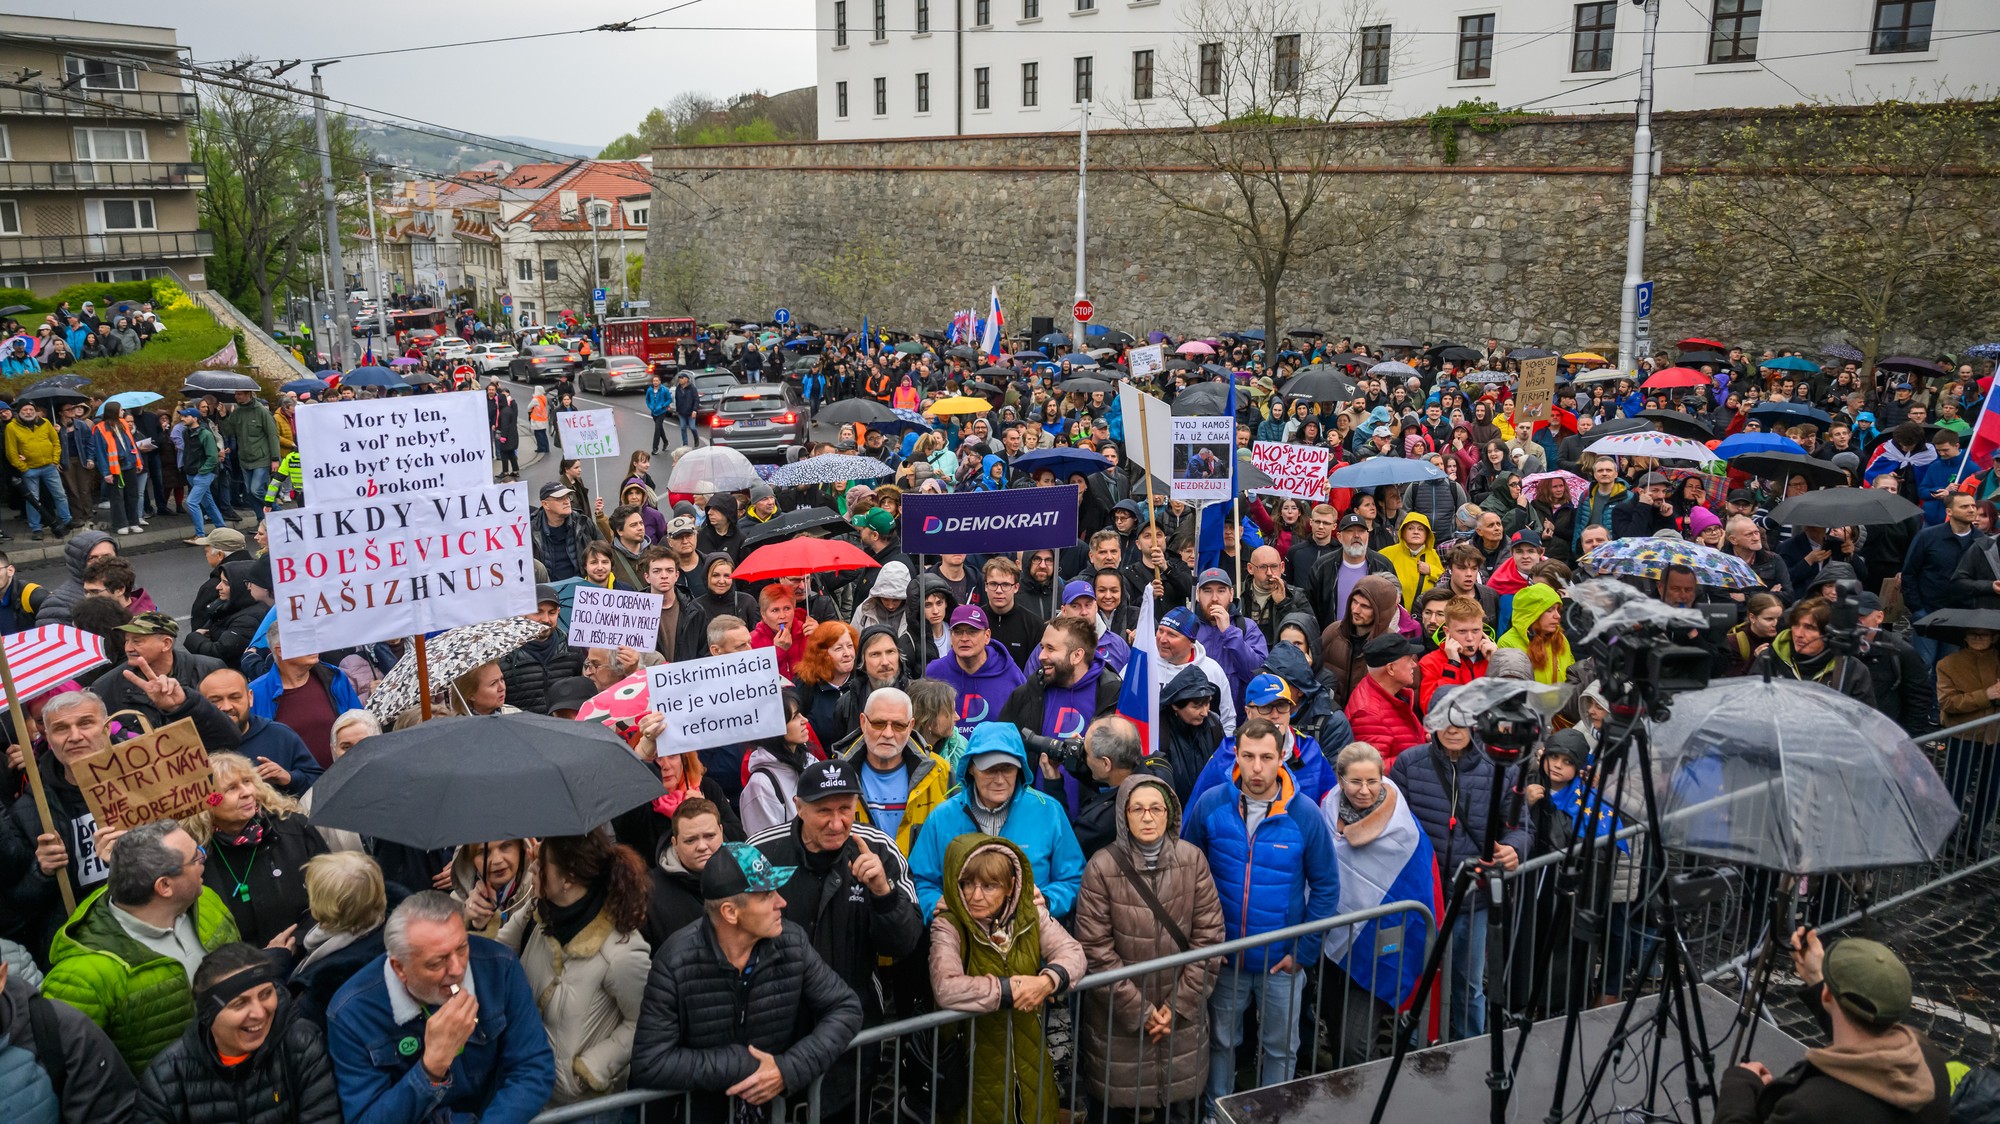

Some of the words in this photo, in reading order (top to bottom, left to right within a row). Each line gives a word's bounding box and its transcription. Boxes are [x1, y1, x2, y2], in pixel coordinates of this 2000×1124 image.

[1074, 306, 1093, 316] STOP
[1639, 288, 1648, 313] P
[343, 414, 384, 429] Mor
[391, 412, 408, 428] ty
[414, 408, 447, 424] len,
[565, 414, 594, 428] VÉGE
[1174, 421, 1197, 429] TVOJ
[1202, 420, 1230, 429] KAMOŠ
[340, 440, 350, 452] a
[357, 434, 390, 451] voľ
[396, 428, 456, 448] nebyť,
[1174, 432, 1185, 440] ŤA
[1191, 432, 1202, 440] UŽ
[1207, 432, 1230, 440] ČAKÁ
[1252, 444, 1282, 462] AKO
[1283, 445, 1294, 454] SA
[1287, 454, 1296, 465] K
[314, 463, 349, 479] ako
[356, 456, 390, 478] byť
[396, 453, 434, 472] tých
[440, 448, 486, 464] volov
[1268, 462, 1291, 476] TAK
[1291, 465, 1307, 476] SA
[1306, 466, 1321, 478] Z
[356, 472, 445, 498] obrokom!
[1174, 480, 1226, 489] NEZDRŽUJ!
[1284, 476, 1325, 497] OZÝVA
[282, 503, 412, 544] NIKDY
[432, 488, 516, 522] VIAC
[945, 511, 1060, 532] DEMOKRATI
[276, 516, 528, 584] BOĽŠEVICKÝ
[579, 591, 600, 606] SMS
[602, 593, 614, 607] OD
[616, 593, 655, 611] ORBÁNA:
[595, 610, 620, 627] ČAKÁM
[631, 616, 637, 628] V
[655, 656, 772, 688] Diskriminácia
[656, 697, 683, 713] nie
[687, 694, 705, 713] je
[708, 681, 778, 706] volebná
[682, 708, 760, 737] reforma!
[88, 733, 184, 782] MOC
[89, 756, 161, 804] PATRÍ
[166, 745, 210, 779] NÁM,
[820, 779, 847, 789] adidas
[101, 796, 130, 819] NIE
